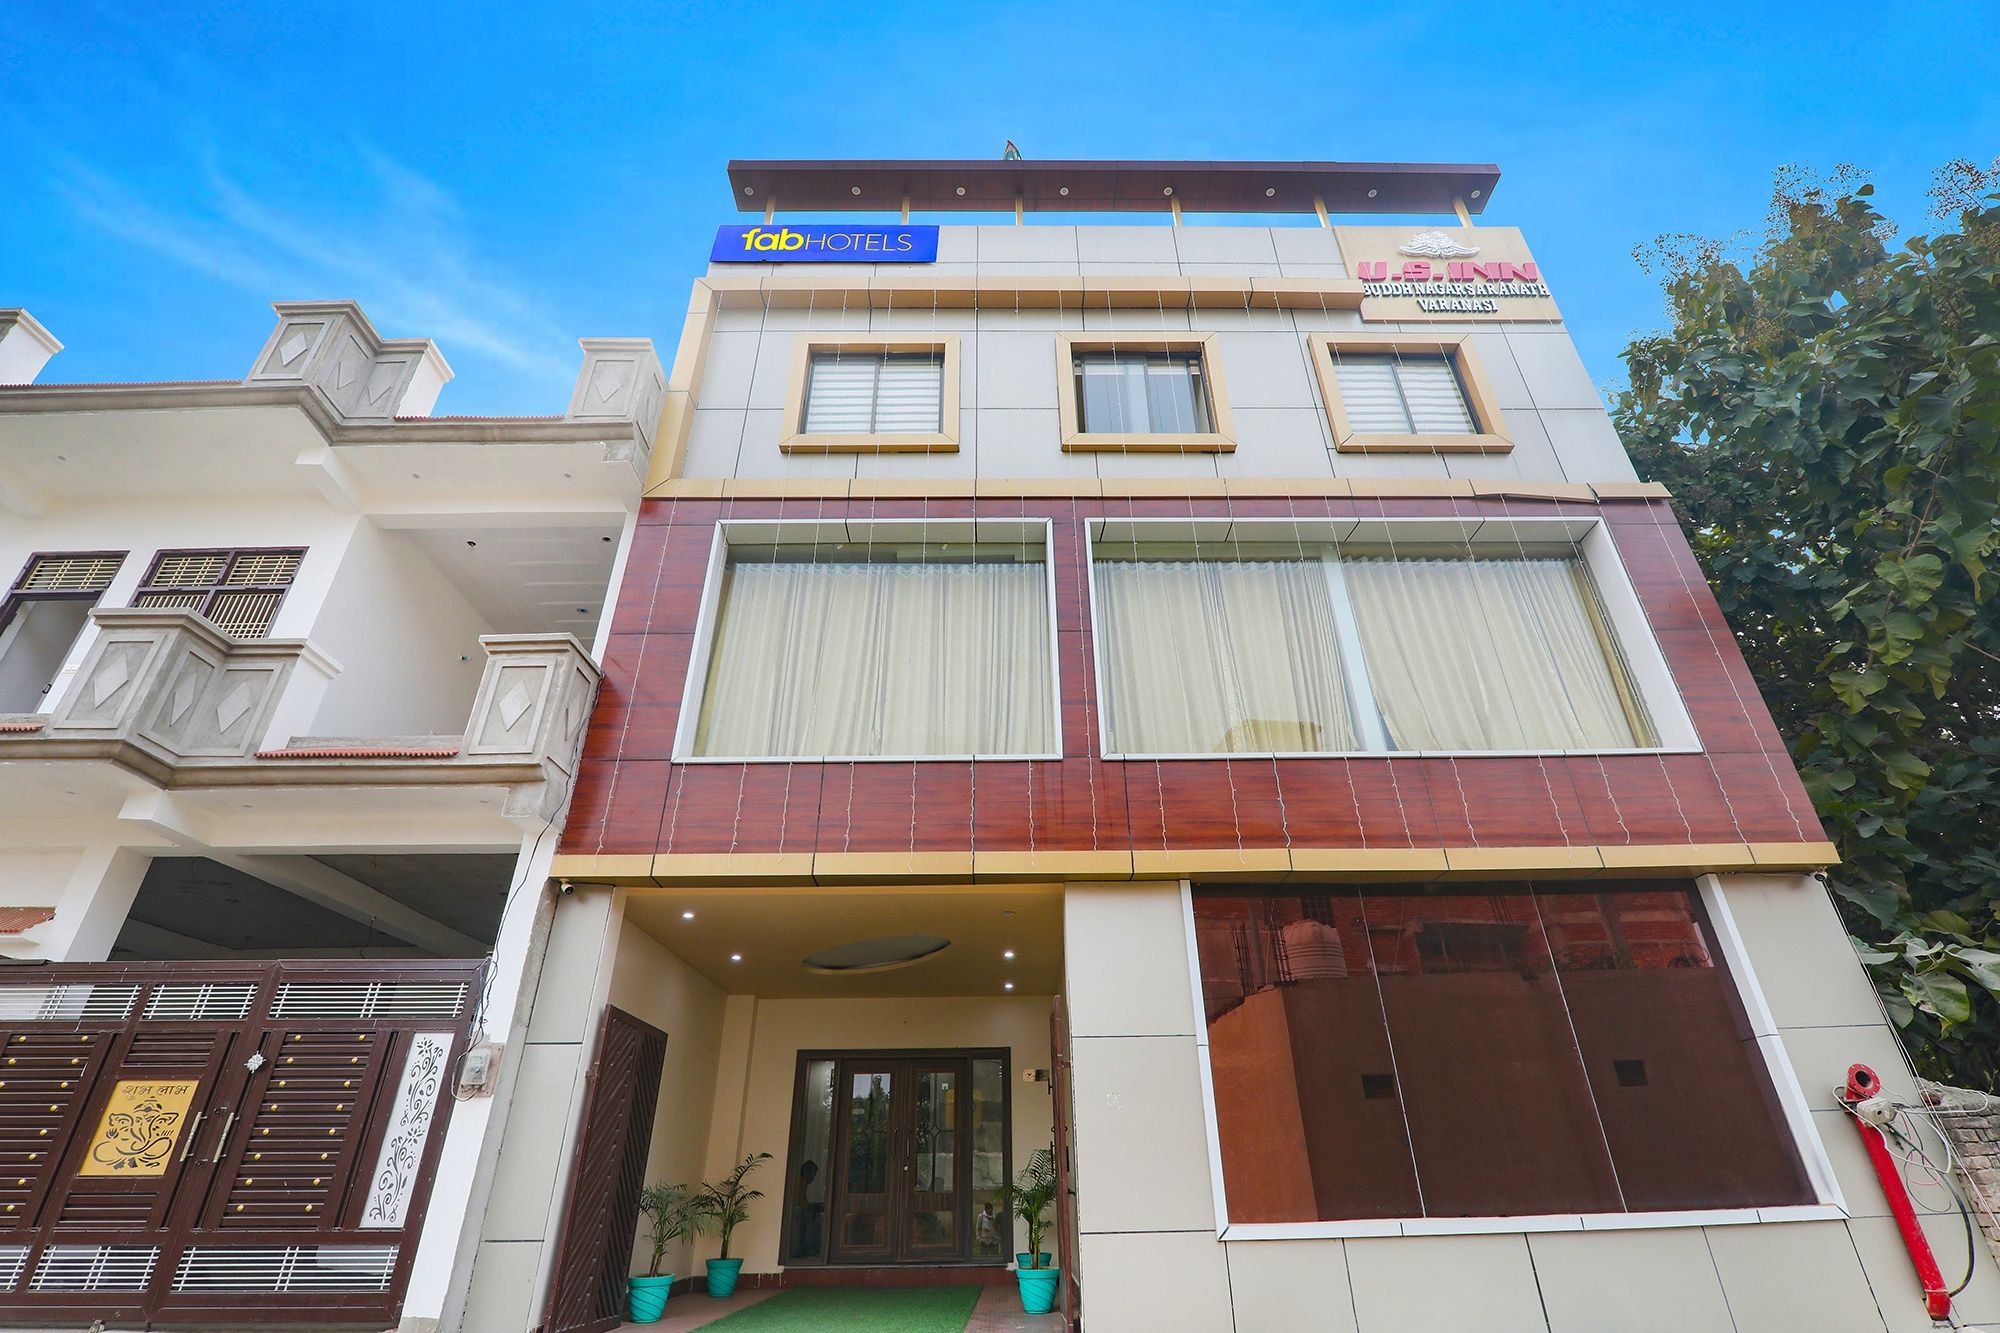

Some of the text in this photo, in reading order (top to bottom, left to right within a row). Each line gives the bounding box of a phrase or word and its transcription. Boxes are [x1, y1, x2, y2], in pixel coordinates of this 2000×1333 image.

[1417, 298, 1498, 313] VARANASI
[122, 1084, 190, 1101] शुभ लाभ
